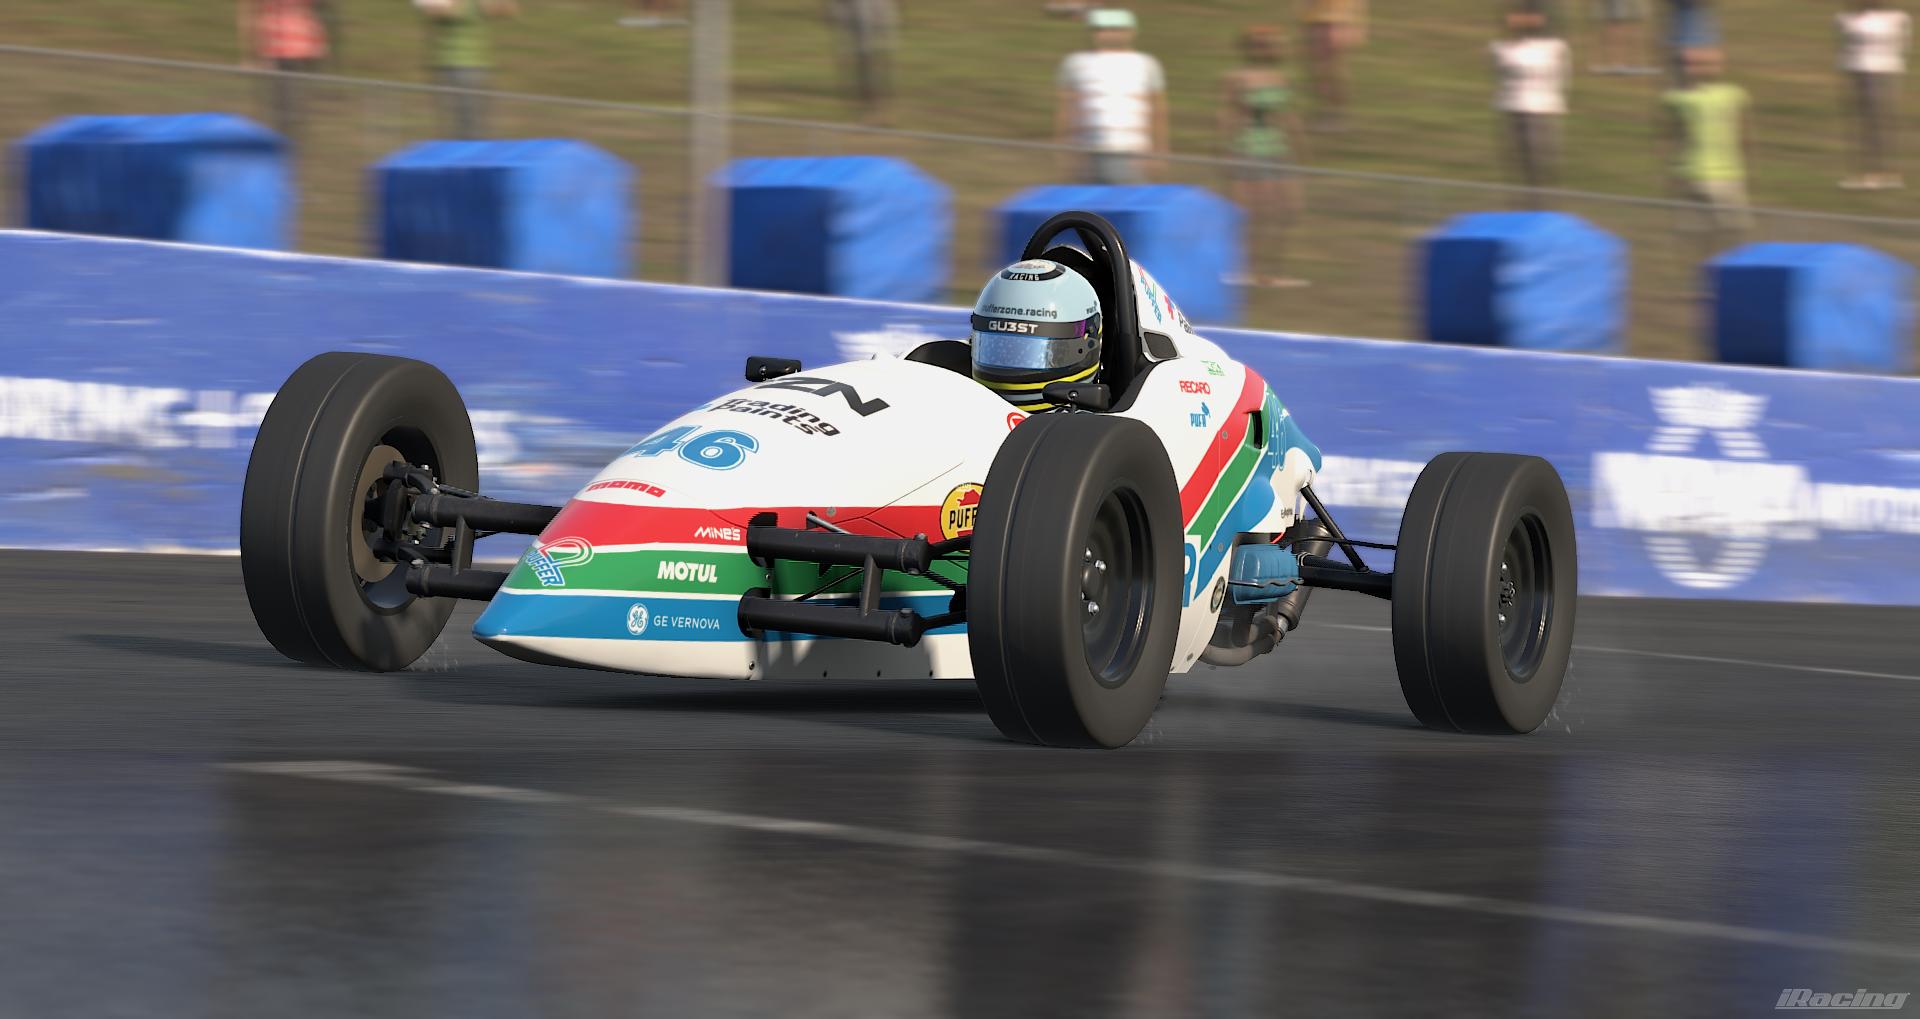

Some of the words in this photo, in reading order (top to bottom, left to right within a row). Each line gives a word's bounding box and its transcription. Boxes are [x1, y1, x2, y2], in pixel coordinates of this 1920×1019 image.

[1008, 273, 1040, 281] RACING
[988, 320, 1039, 334] GU3ST
[1179, 380, 1211, 395] RECARO
[624, 425, 760, 471] 46
[657, 560, 718, 583] MOTUL
[653, 615, 668, 628] GE
[671, 616, 720, 630] VERNOVA
